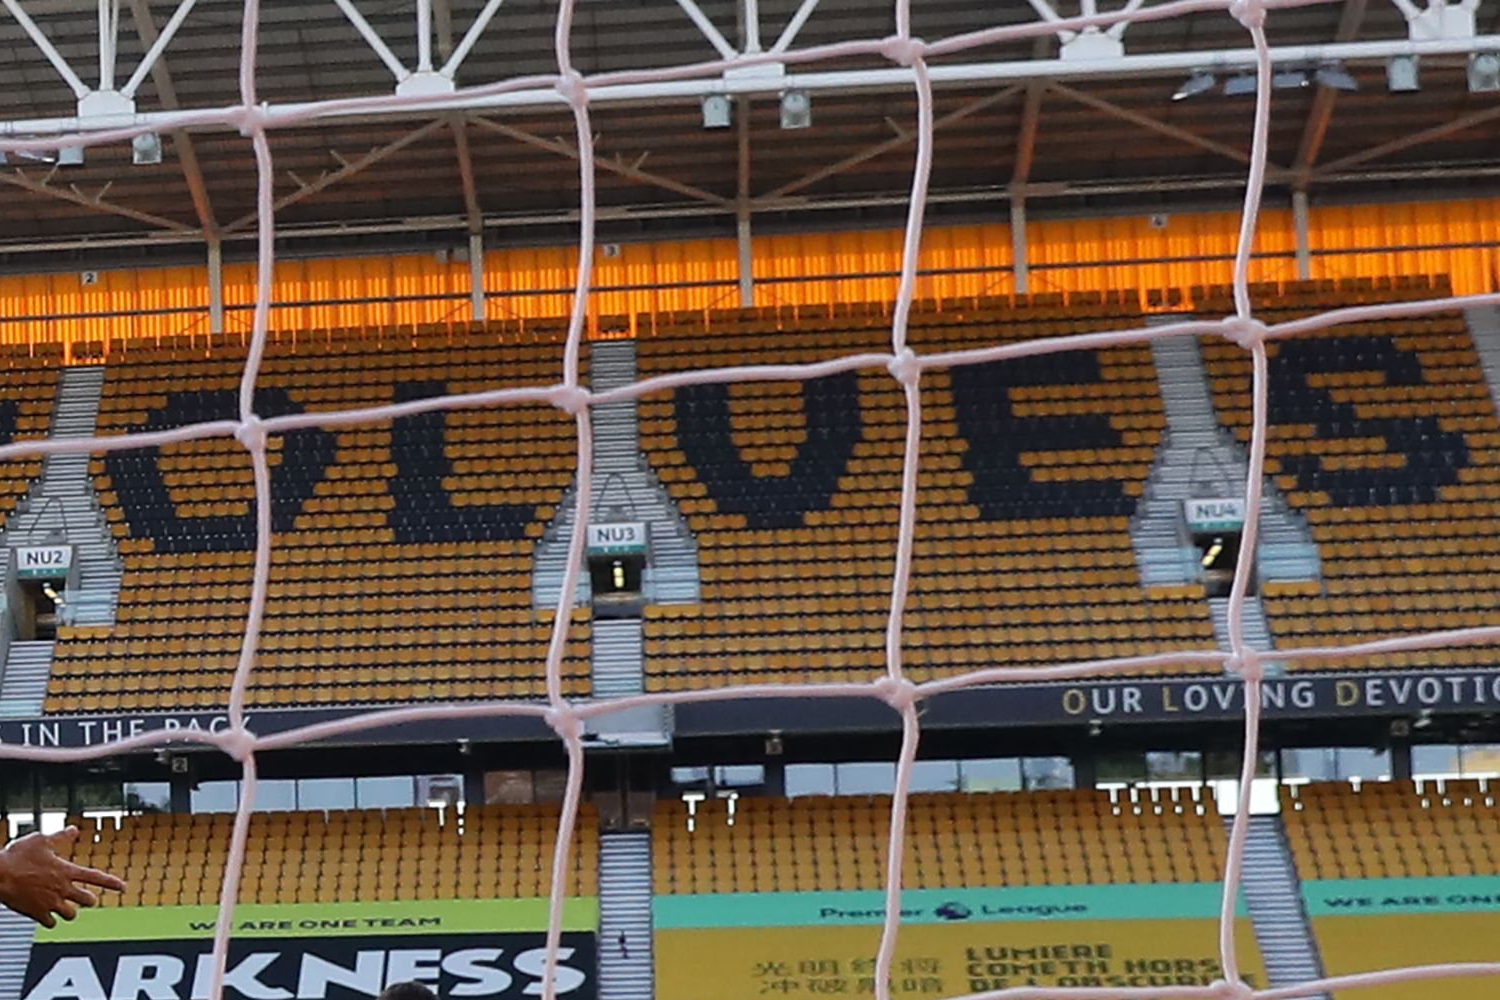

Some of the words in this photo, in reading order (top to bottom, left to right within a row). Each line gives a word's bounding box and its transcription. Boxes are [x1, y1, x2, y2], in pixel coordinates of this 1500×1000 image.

[597, 526, 636, 542] NU3
[26, 551, 63, 565] NU2
[1062, 688, 1143, 715] OUR
[22, 723, 60, 747] IN
[78, 719, 145, 745] THE
[1323, 897, 1374, 908] WE
[1445, 893, 1500, 904] ON
[818, 906, 925, 919] Premer
[238, 920, 293, 931] ARE
[298, 919, 357, 930] ONE
[362, 917, 442, 928] TEAM
[965, 944, 1113, 961] LUMIERE
[966, 959, 1110, 976] COMETH
[1124, 957, 1222, 974] HORS
